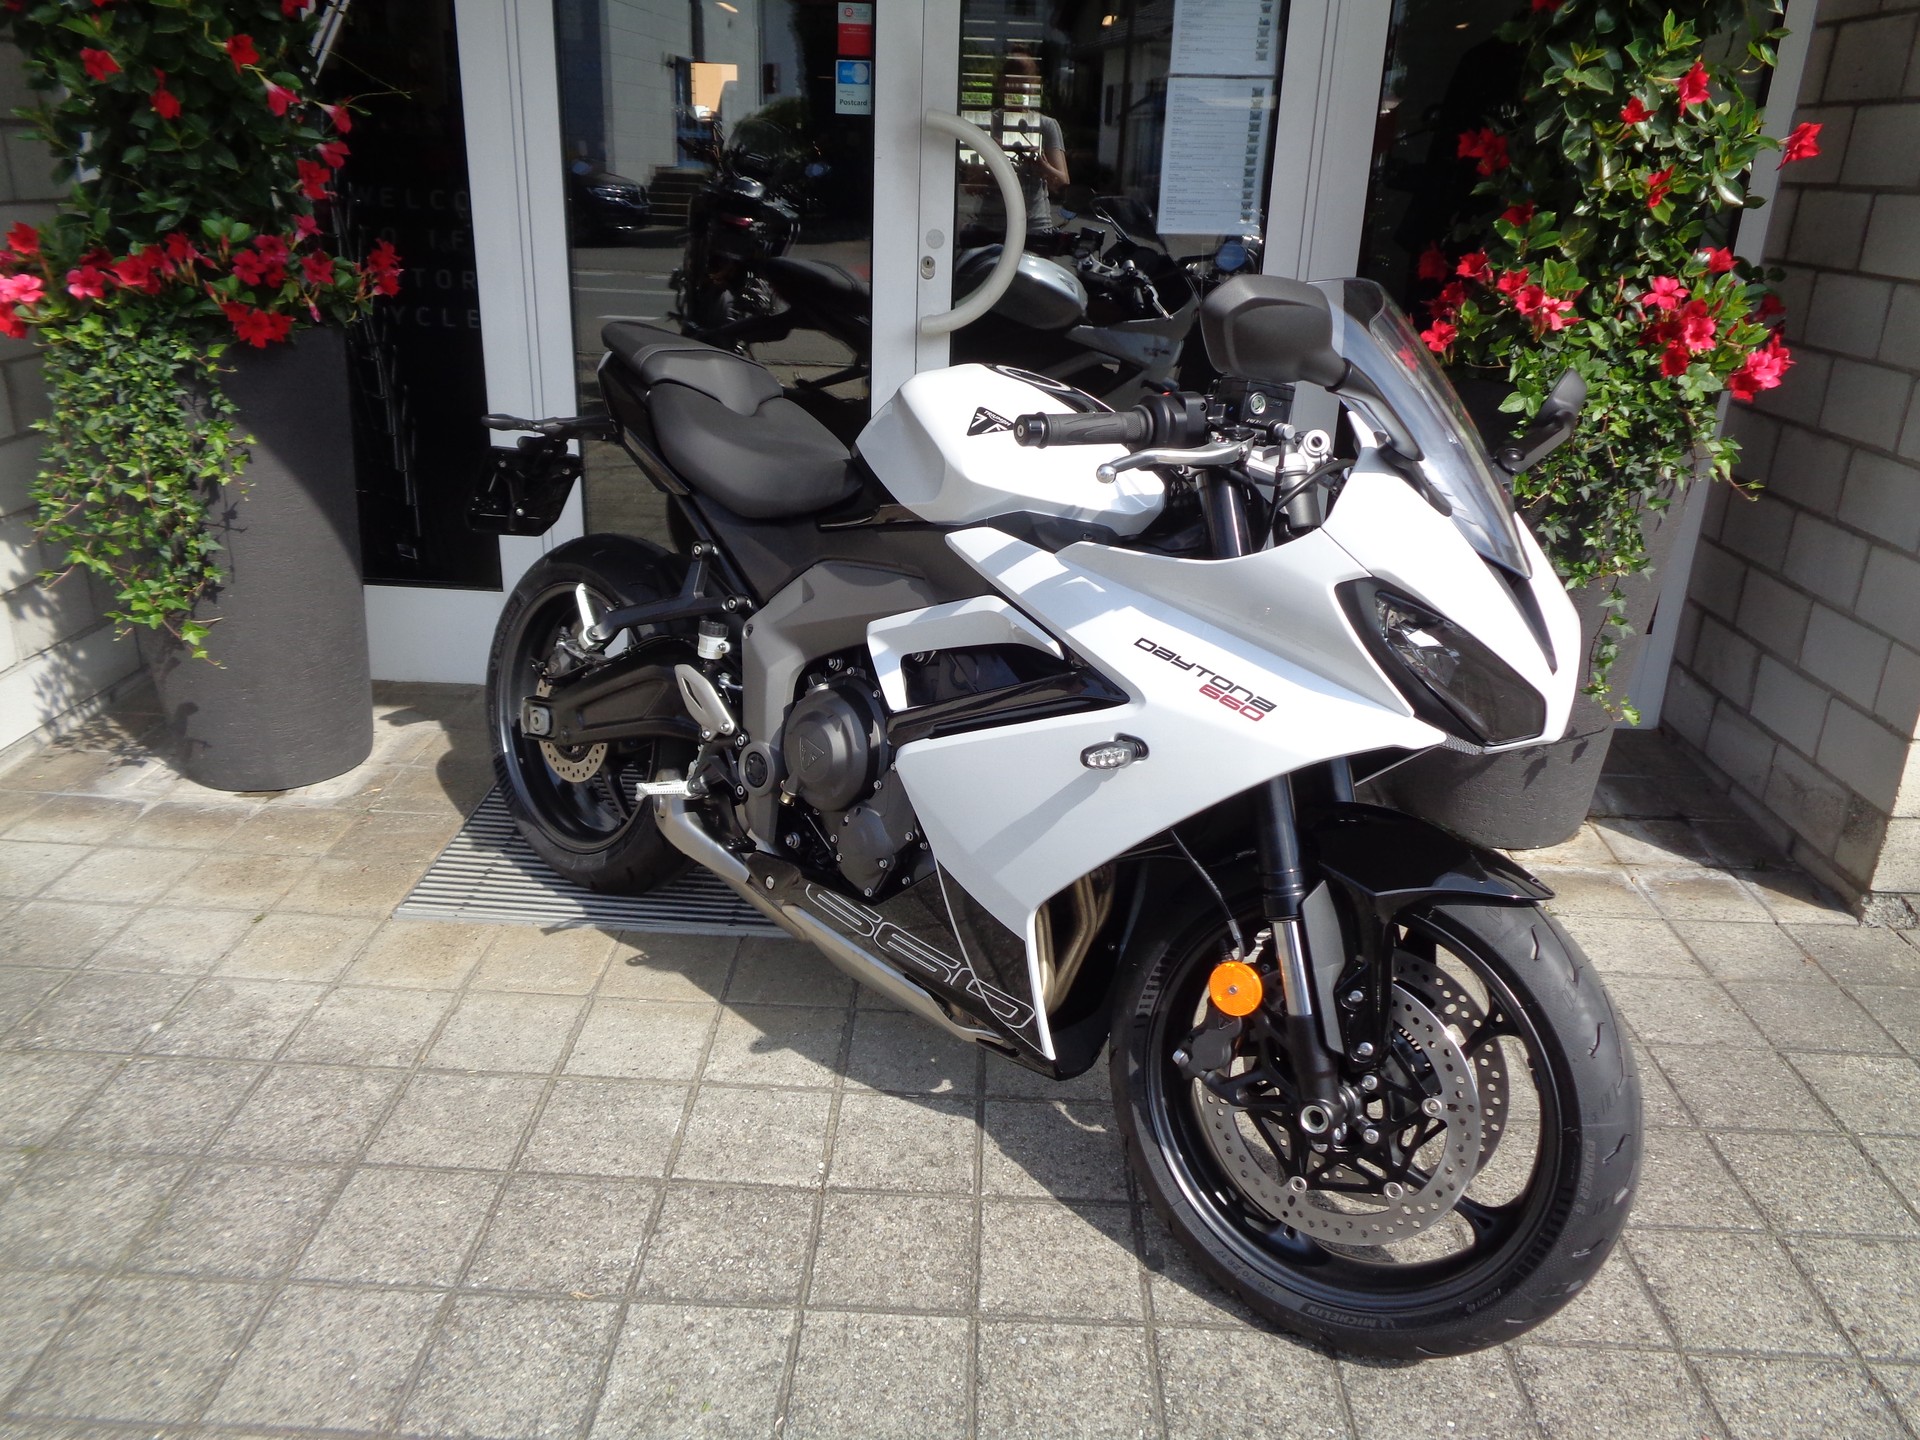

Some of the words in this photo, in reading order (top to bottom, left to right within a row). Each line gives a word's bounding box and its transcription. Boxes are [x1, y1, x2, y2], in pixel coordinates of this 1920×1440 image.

[839, 98, 868, 107] Postcard
[983, 410, 1012, 427] TRIUMPH
[1198, 683, 1265, 722] 660
[1307, 1304, 1377, 1327] MICHELIN
